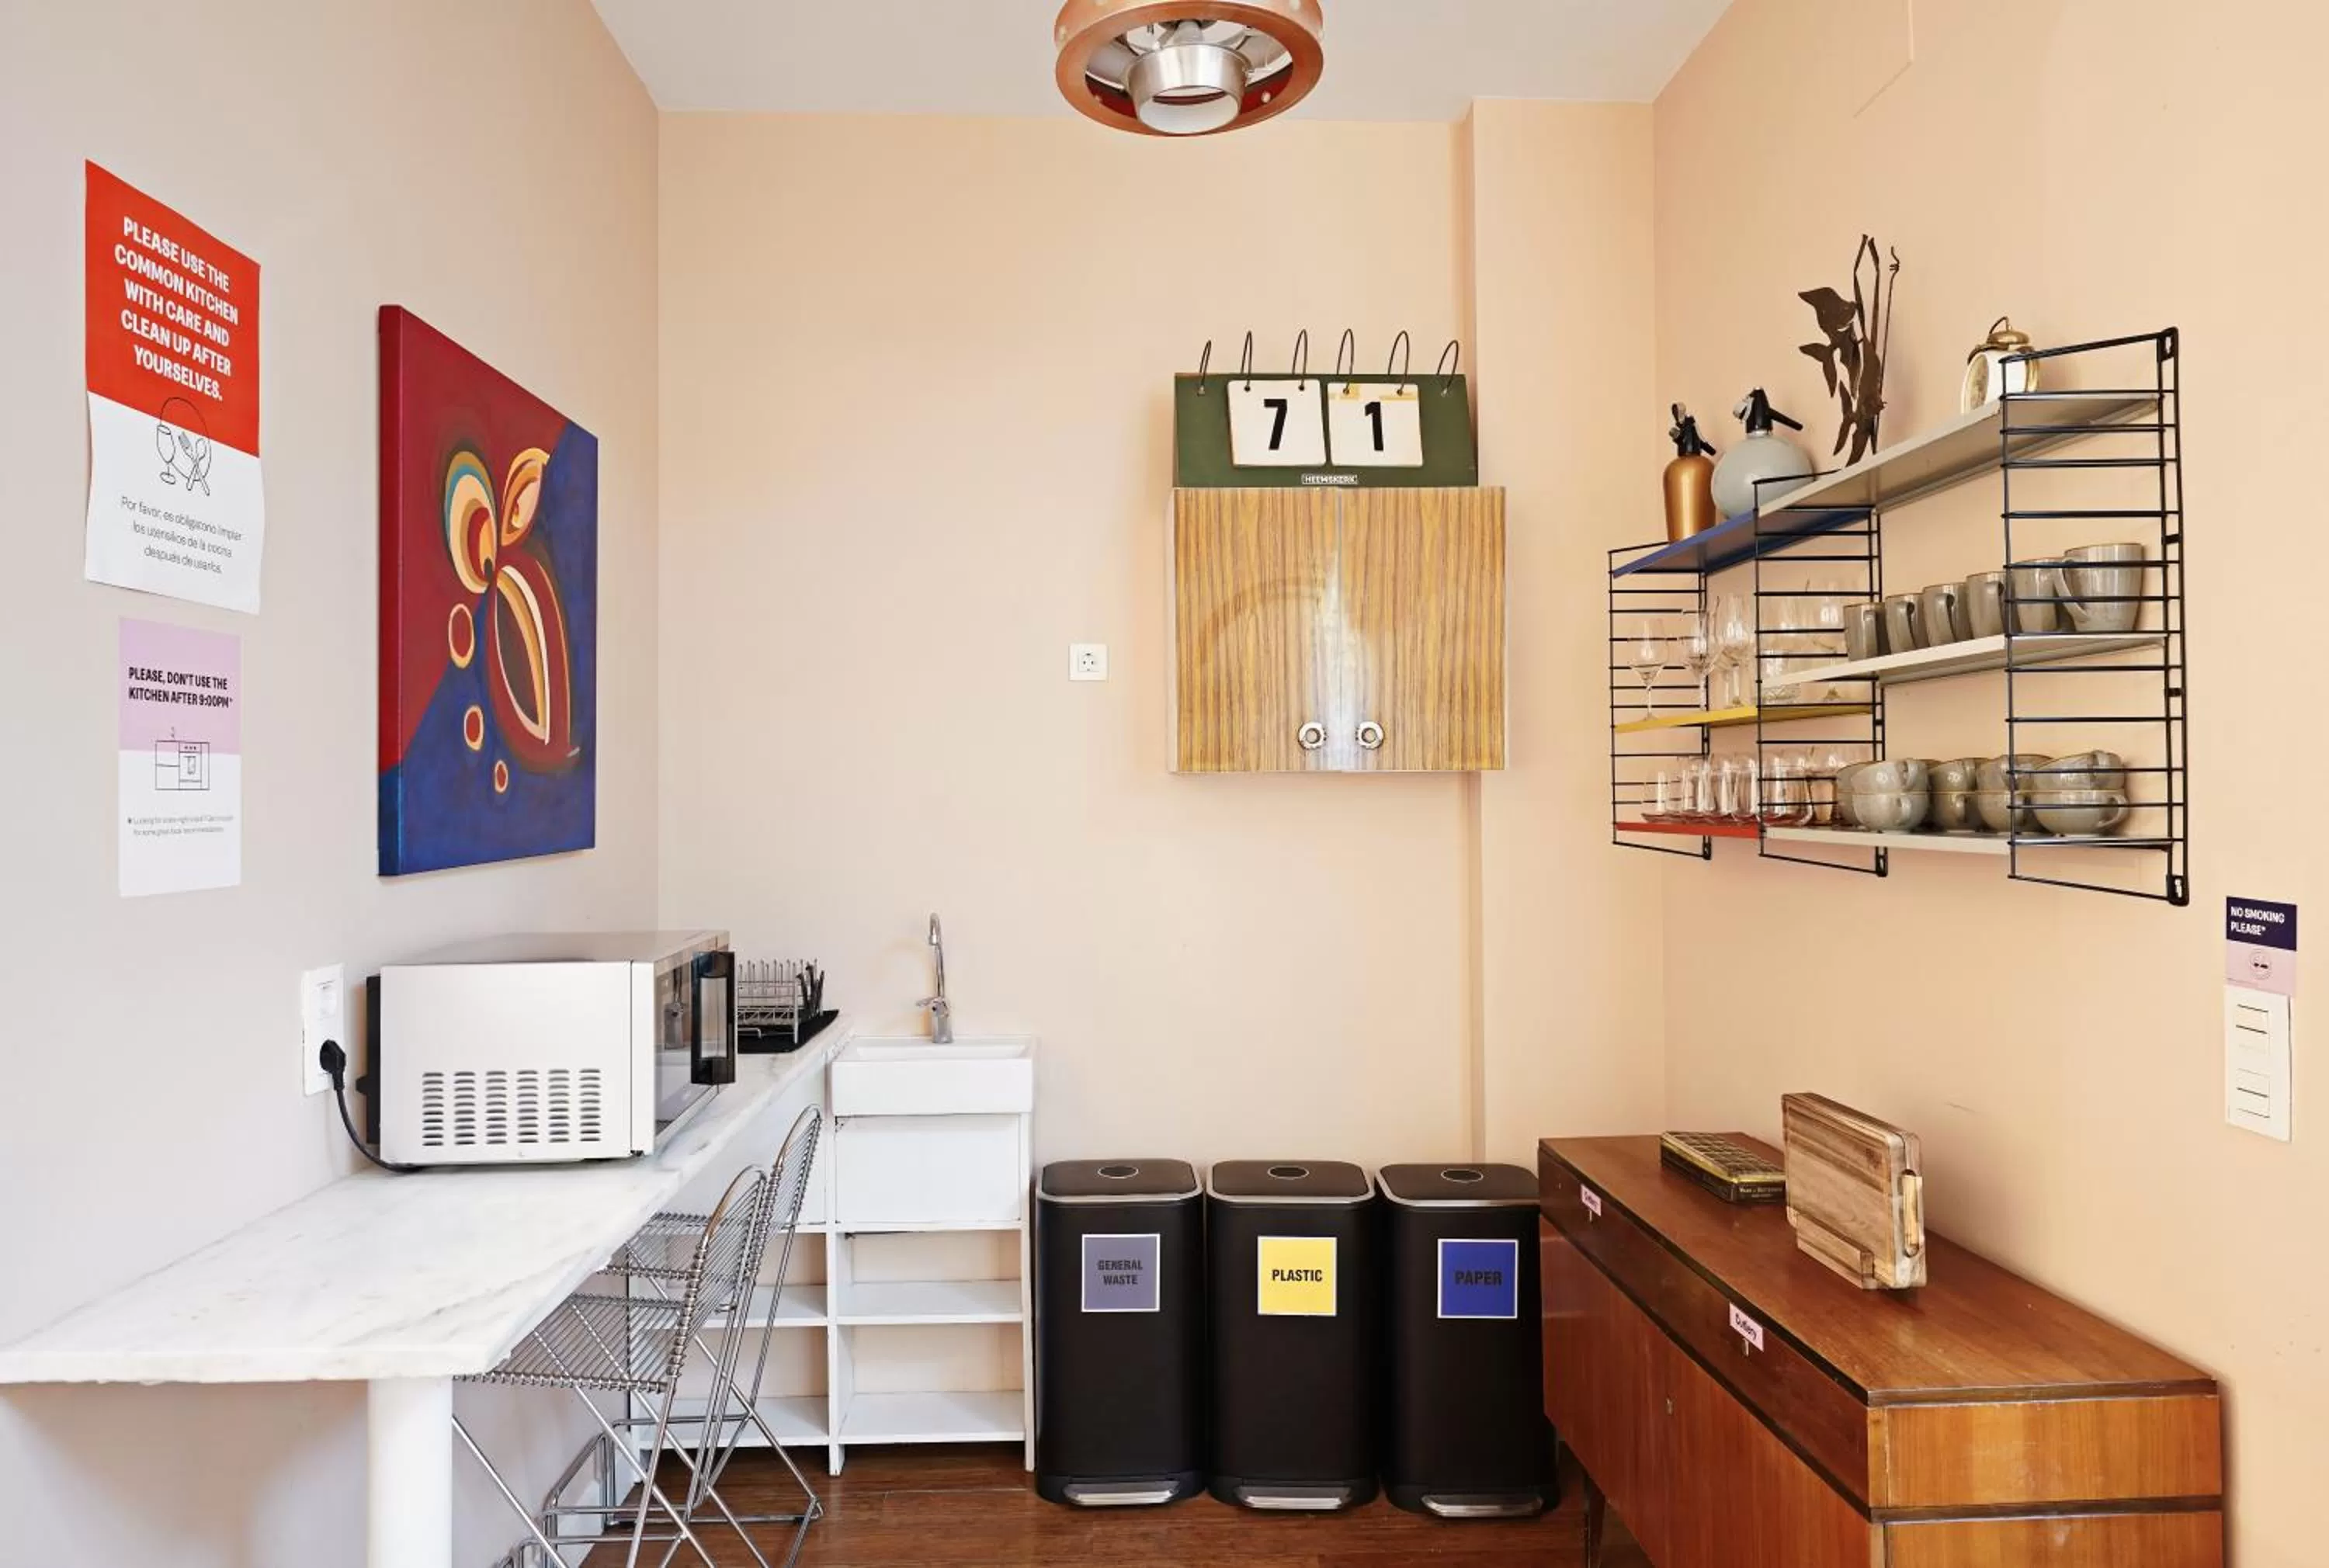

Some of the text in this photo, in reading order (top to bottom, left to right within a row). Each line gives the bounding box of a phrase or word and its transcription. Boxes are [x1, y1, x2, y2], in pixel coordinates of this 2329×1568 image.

[123, 217, 229, 293] PLEASE USE THE
[114, 245, 238, 324] COMMON KITCHEN
[124, 279, 229, 347] WITH CARE AND
[121, 310, 231, 376] CLEAN UP AFTER
[134, 345, 223, 401] YOURSELVES.
[1263, 398, 1384, 452] 7 1
[121, 496, 137, 510] Por
[163, 512, 175, 522] es
[133, 519, 145, 534] los
[188, 536, 197, 548] de
[199, 537, 206, 550] la
[182, 553, 193, 567] de
[128, 667, 227, 690] PLEASE, DON'T USE THE
[128, 687, 169, 702] KITCHEN
[171, 691, 198, 706] AFTER
[2230, 906, 2285, 924] NO SMOKING
[1098, 1259, 1143, 1271] GENERAL
[1272, 1269, 1323, 1282] PLASTIC
[1102, 1275, 1138, 1285] WASTE
[1454, 1270, 1502, 1285] PAPER
